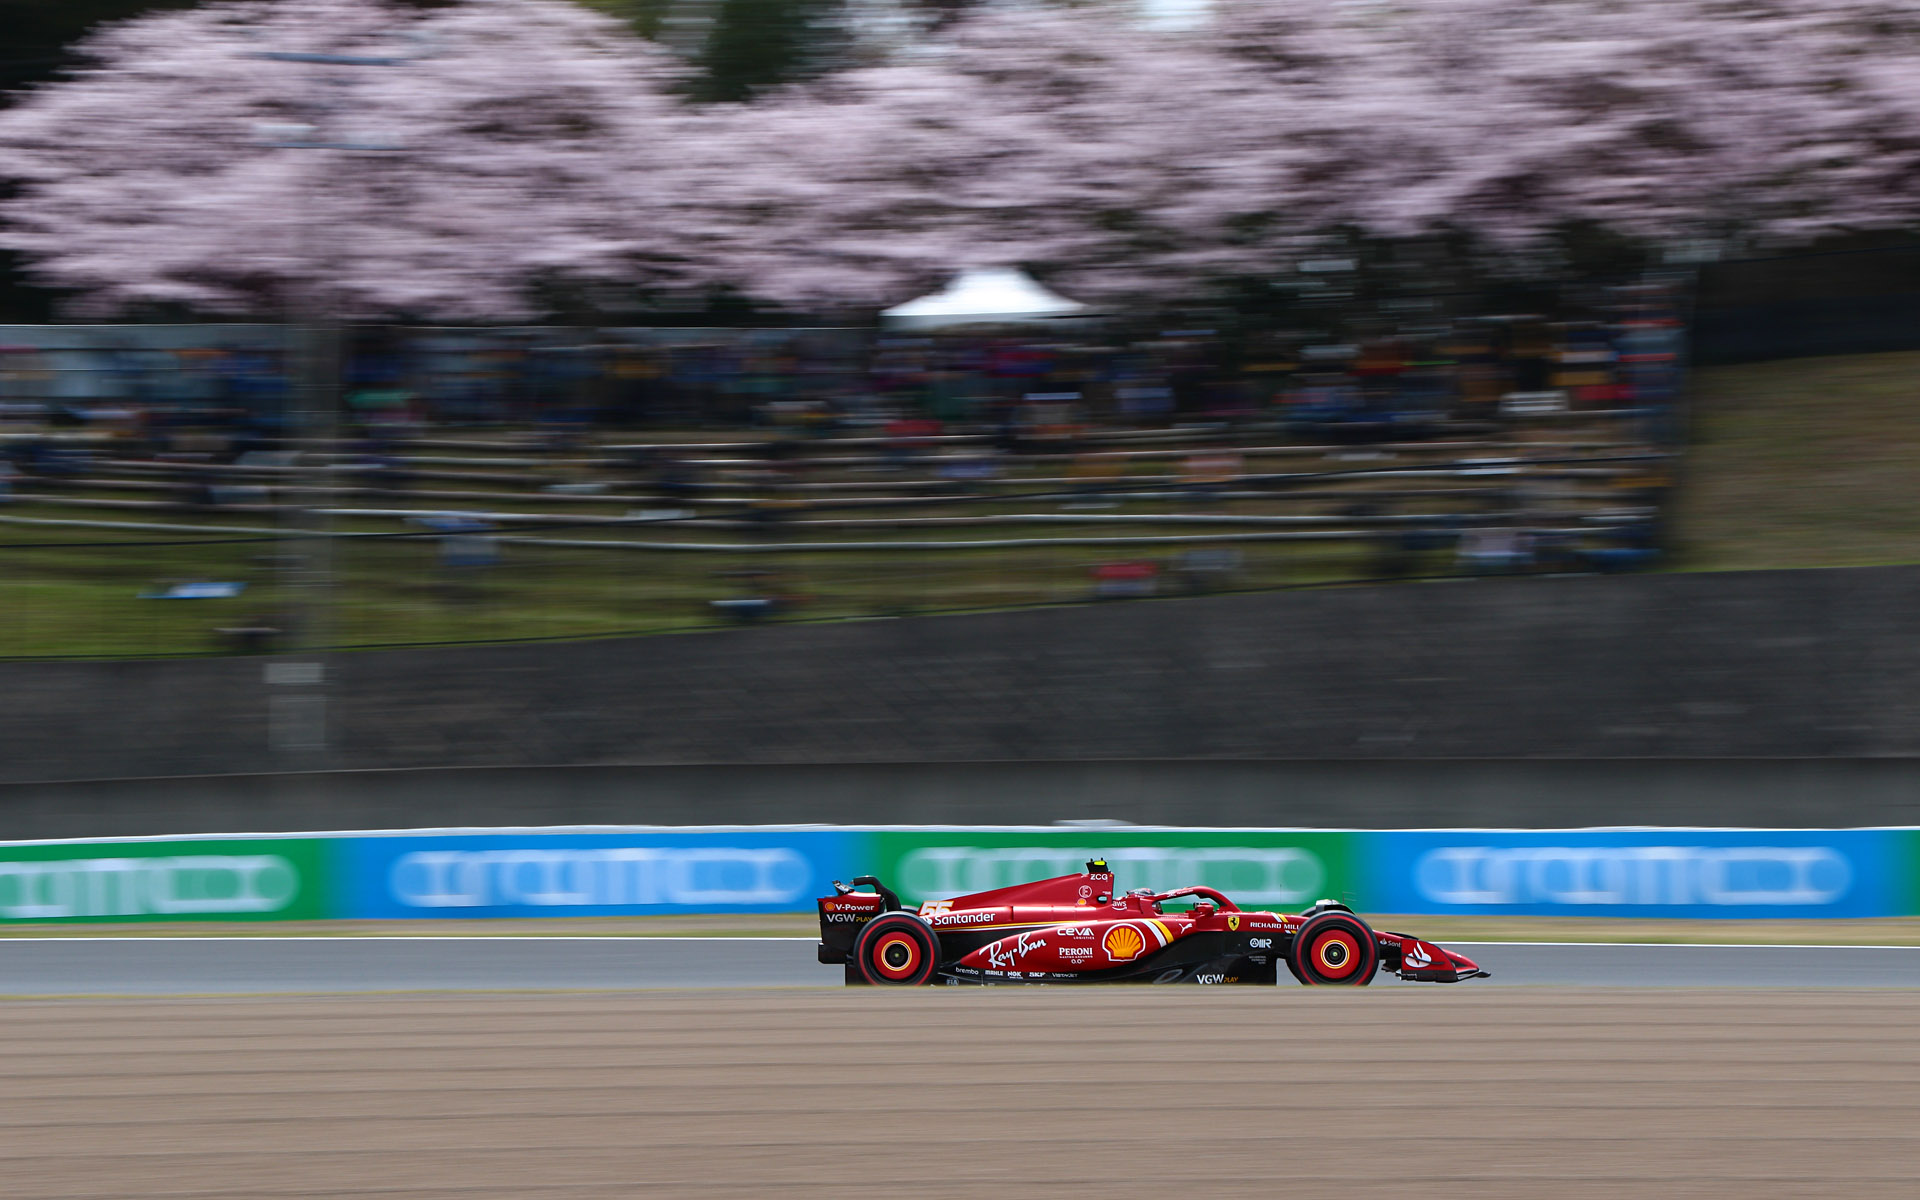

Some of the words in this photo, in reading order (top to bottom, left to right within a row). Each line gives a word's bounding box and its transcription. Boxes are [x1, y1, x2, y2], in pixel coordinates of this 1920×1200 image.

[919, 901, 954, 916] 55
[826, 913, 856, 923] VGW
[934, 912, 996, 926] Santander
[979, 932, 1047, 969] Ray-Ban
[1059, 947, 1093, 956] PERONI
[955, 966, 979, 975] brembo
[984, 969, 1003, 977] MAHLE
[1196, 974, 1225, 985] VGW
